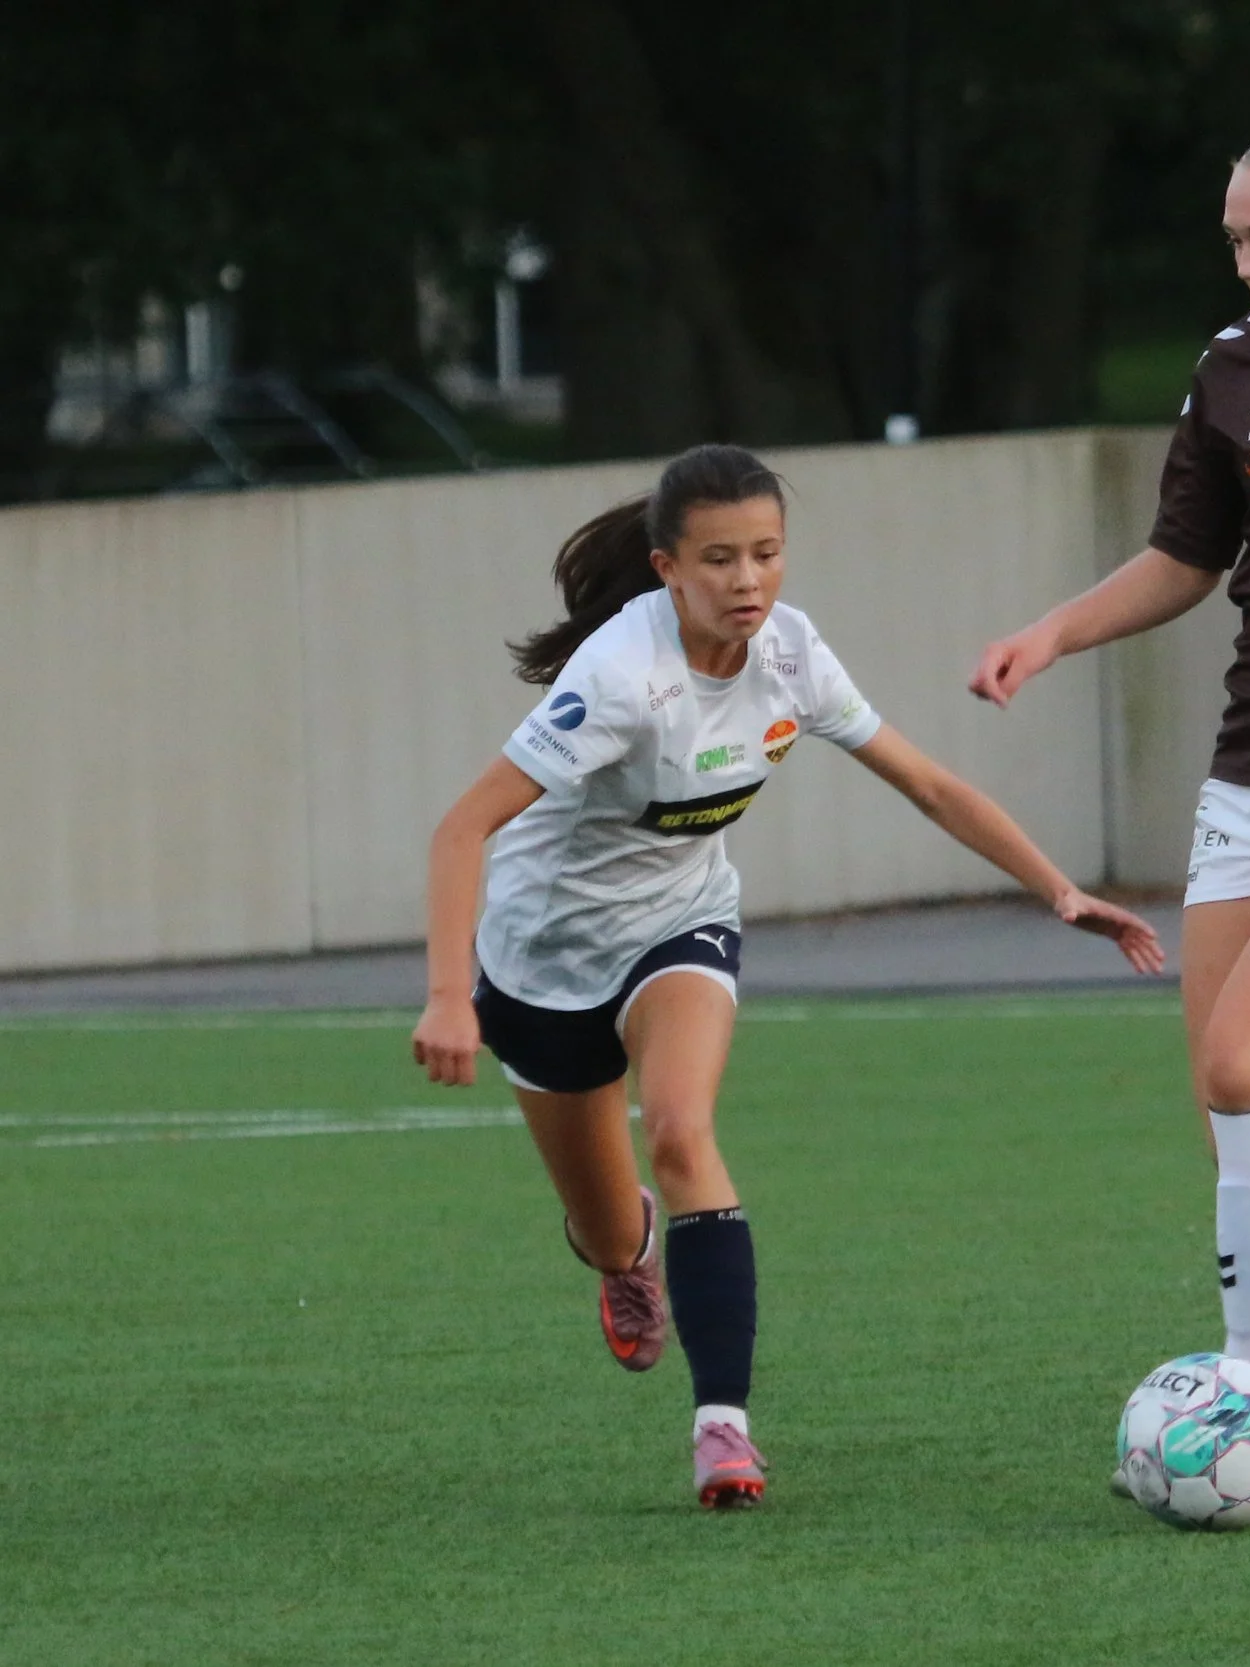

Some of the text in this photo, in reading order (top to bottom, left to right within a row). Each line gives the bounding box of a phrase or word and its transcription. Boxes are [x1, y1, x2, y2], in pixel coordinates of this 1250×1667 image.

[760, 657, 798, 677] ENRGI
[650, 683, 685, 713] ENRGI
[526, 735, 547, 754] ØST
